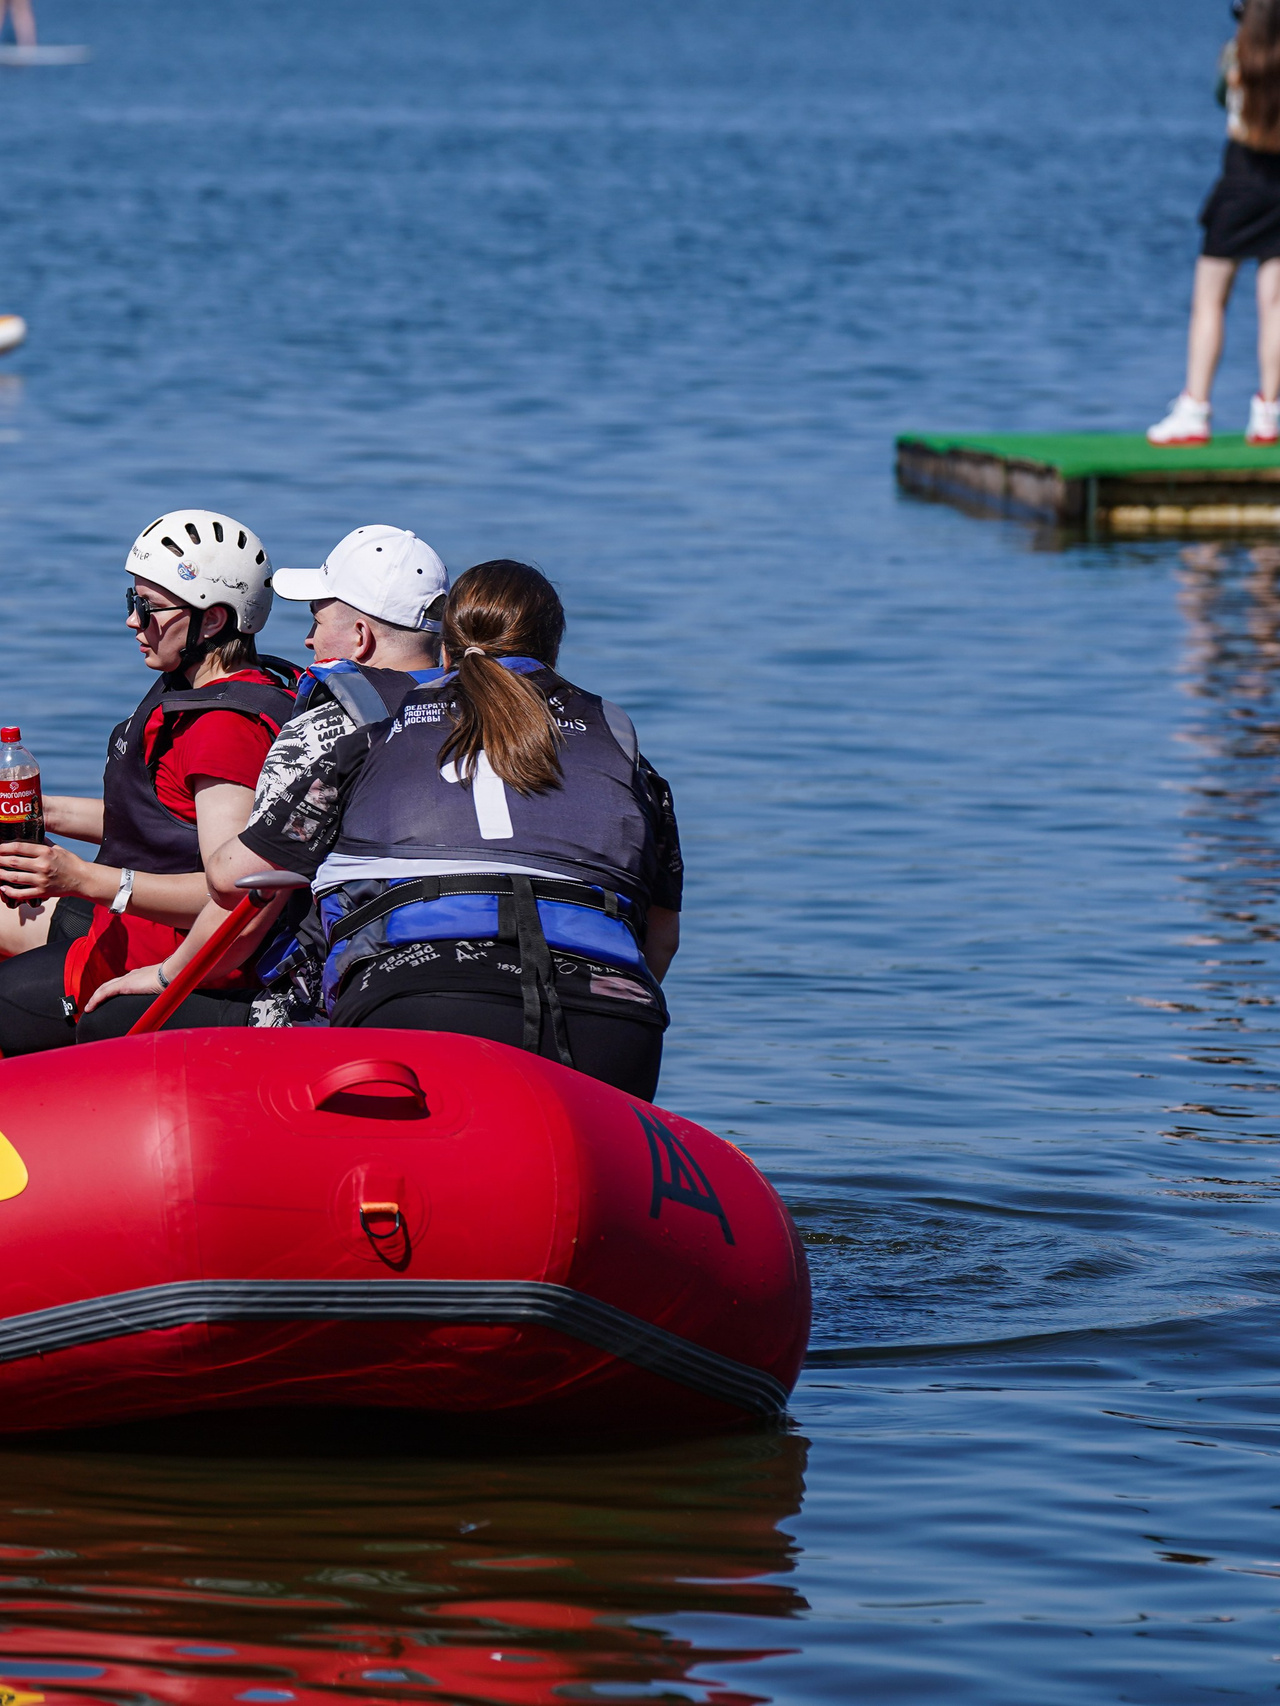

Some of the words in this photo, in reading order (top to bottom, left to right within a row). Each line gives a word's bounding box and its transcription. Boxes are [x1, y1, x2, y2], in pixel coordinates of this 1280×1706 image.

[404, 715, 441, 728] МОСКВЫ
[554, 717, 587, 732] DIS
[439, 749, 514, 840] 1
[0, 800, 32, 815] Cola
[409, 952, 441, 968] THE
